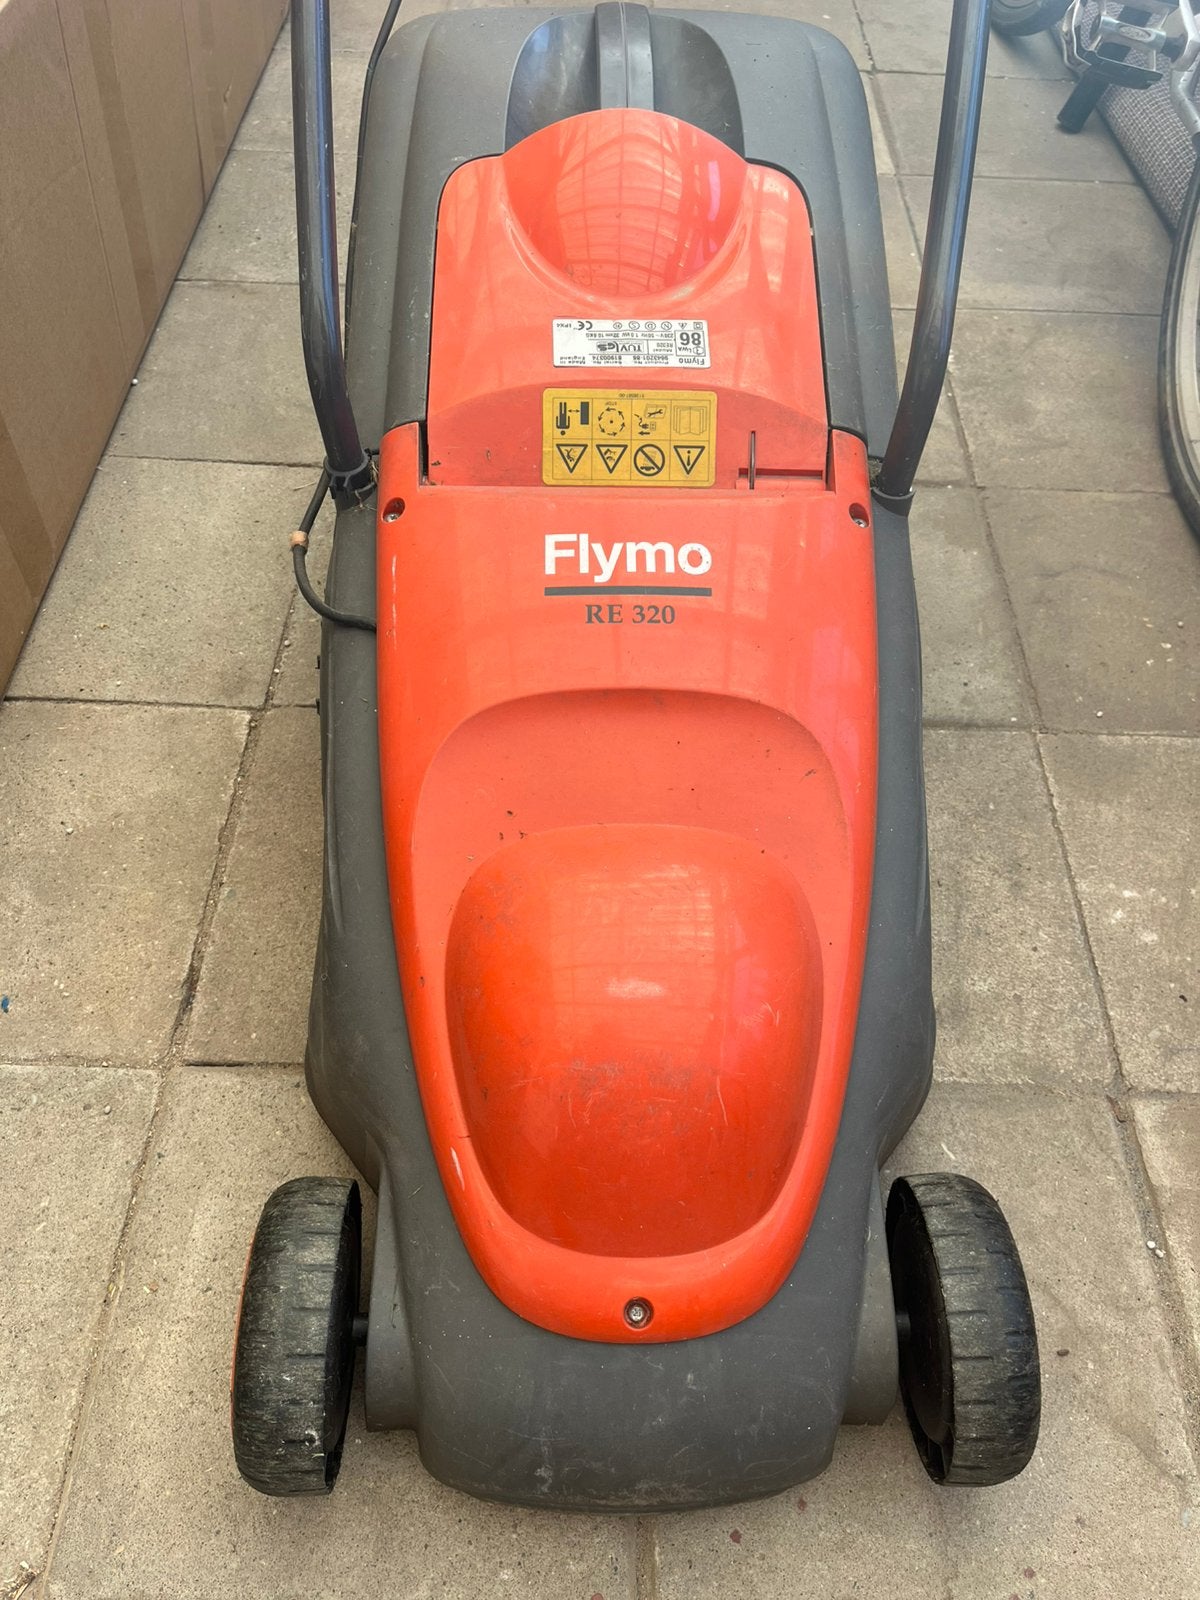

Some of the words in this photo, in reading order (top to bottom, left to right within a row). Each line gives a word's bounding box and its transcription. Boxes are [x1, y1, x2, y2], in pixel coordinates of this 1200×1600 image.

[679, 332, 701, 345] 86
[544, 533, 713, 583] Flymo
[585, 604, 624, 624] RE
[632, 604, 676, 624] 320
